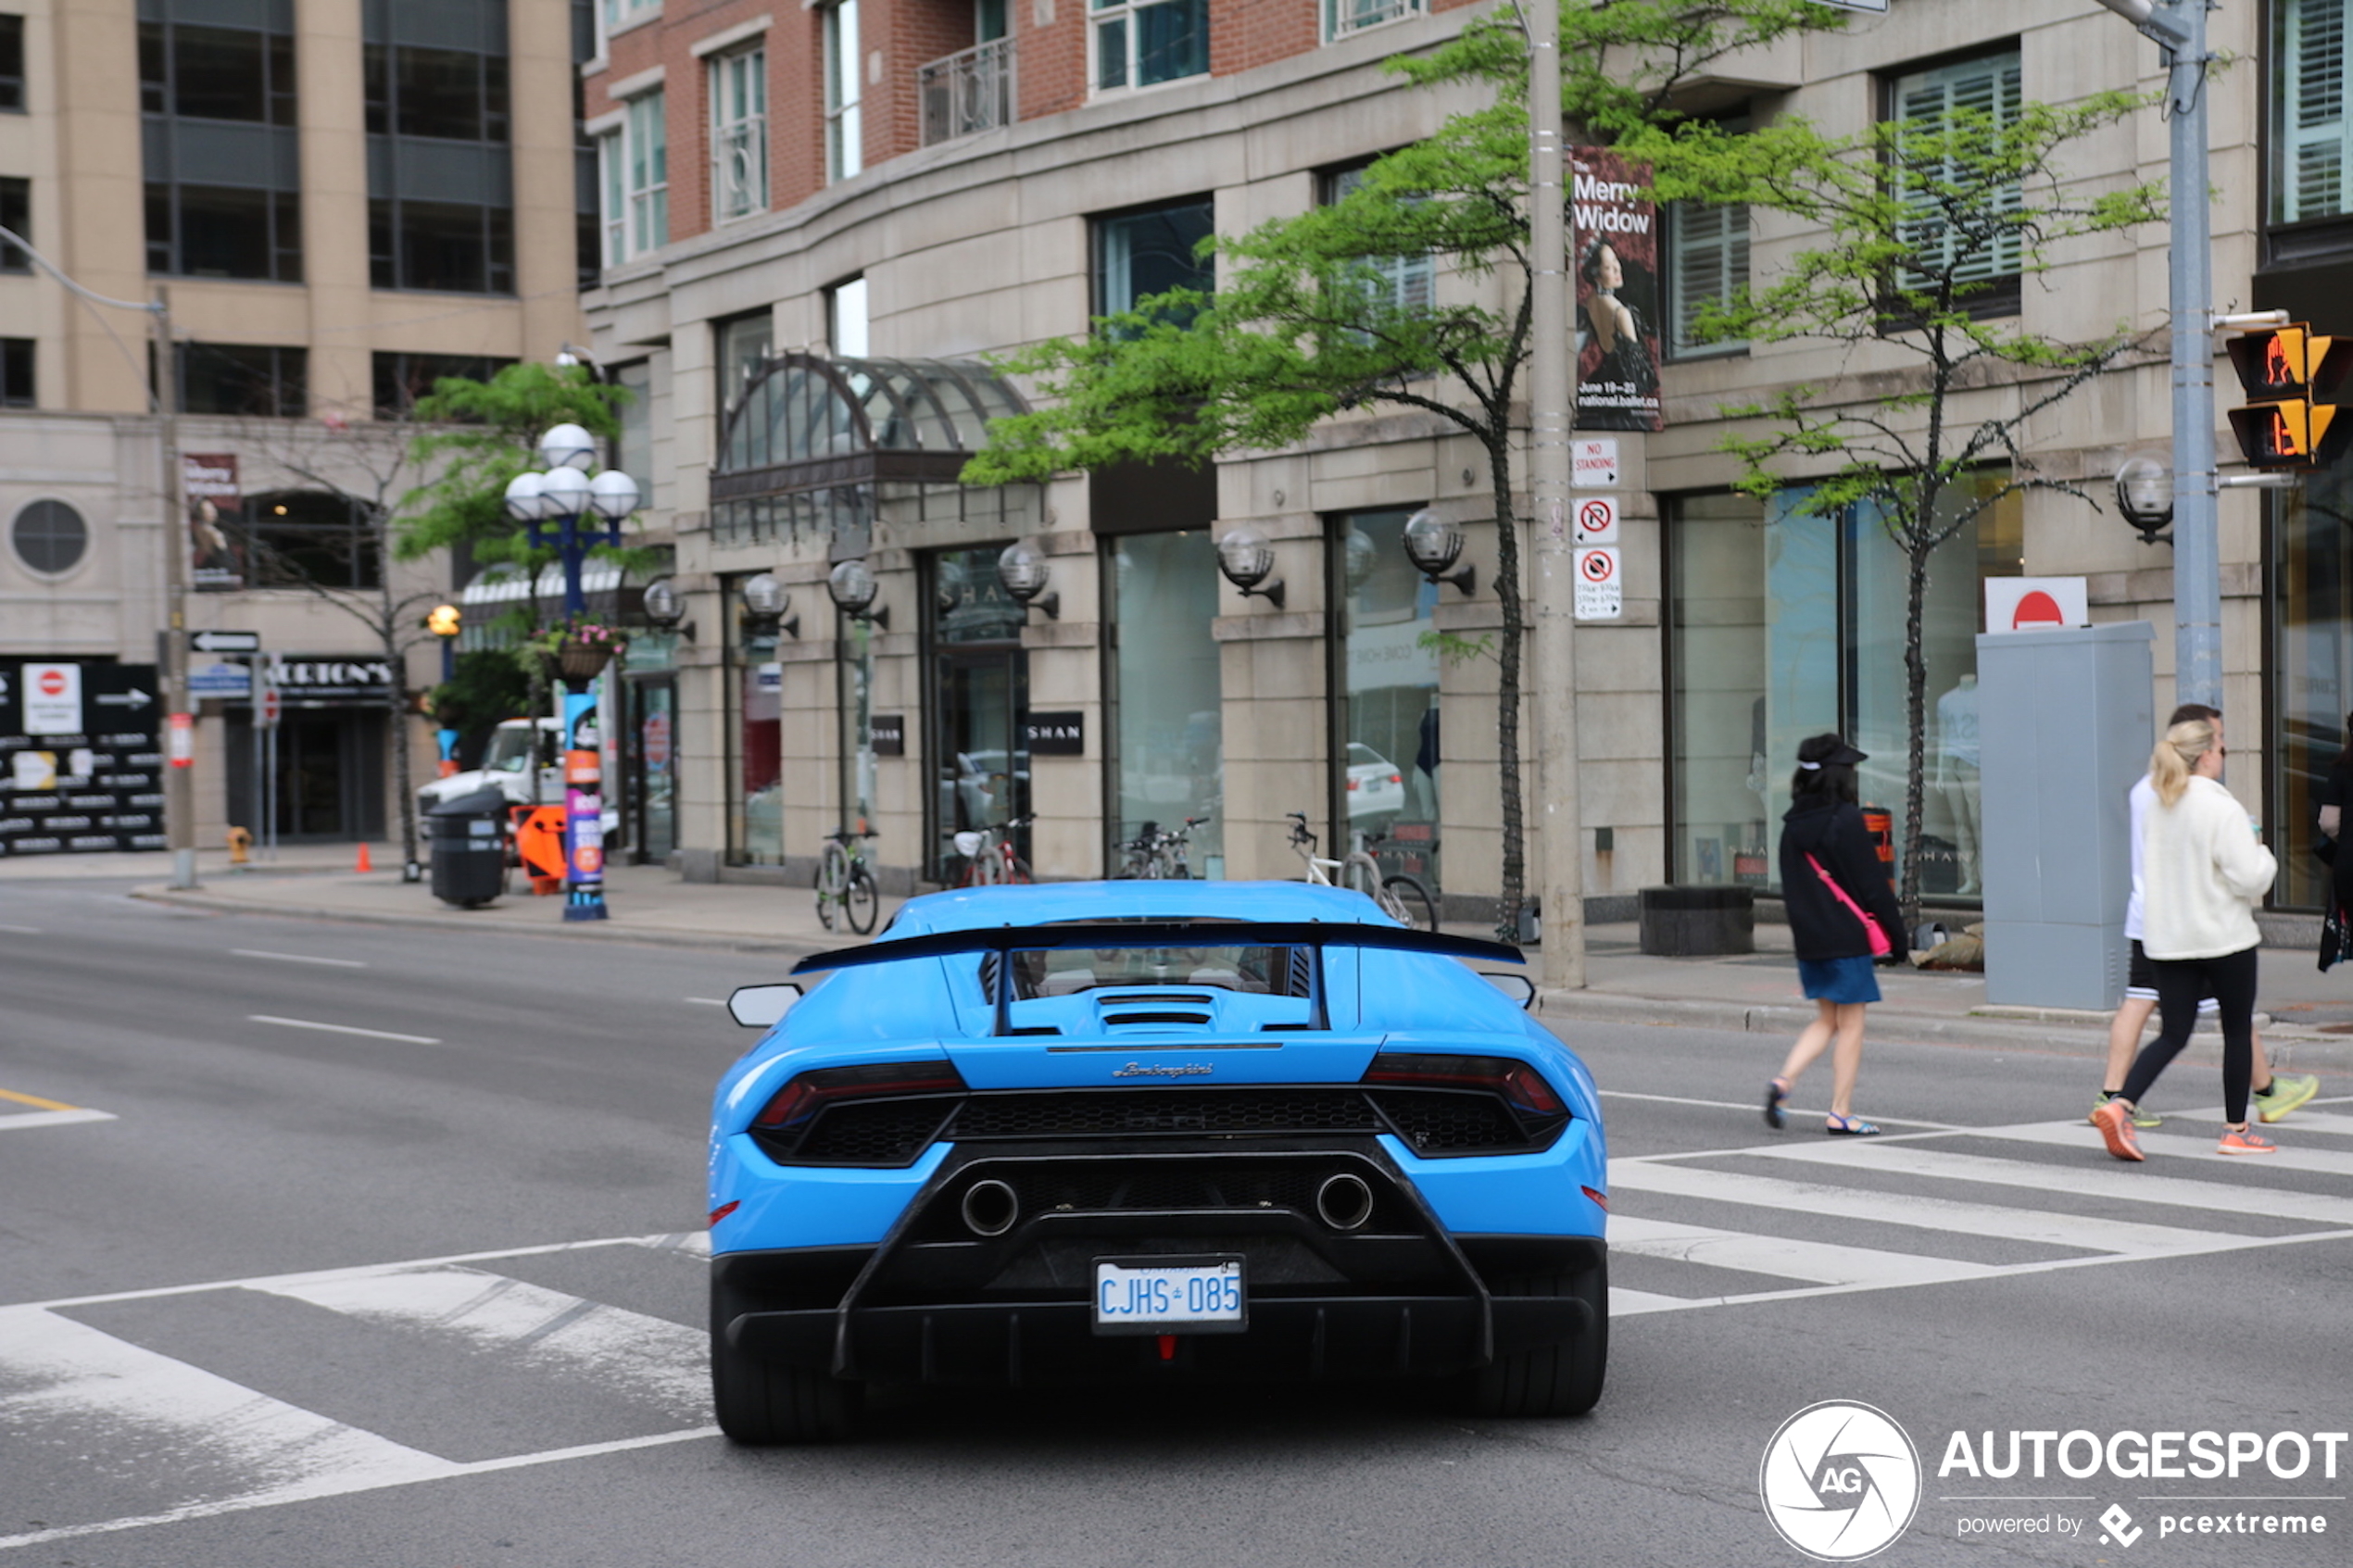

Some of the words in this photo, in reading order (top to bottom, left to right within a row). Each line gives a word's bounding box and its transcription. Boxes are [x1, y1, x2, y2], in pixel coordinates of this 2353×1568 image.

[1574, 174, 1638, 207] Merry
[1574, 205, 1650, 234] Widow
[1579, 382, 1603, 394] June
[1587, 444, 1602, 455] NO
[1576, 457, 1616, 471] STANDING
[938, 584, 1013, 606] SHA
[1028, 725, 1080, 739] SHAN
[1918, 851, 1974, 862] HAN
[1112, 1061, 1213, 1078] Lamborghini
[1101, 1278, 1169, 1314] CJHS
[1189, 1276, 1240, 1312] 085
